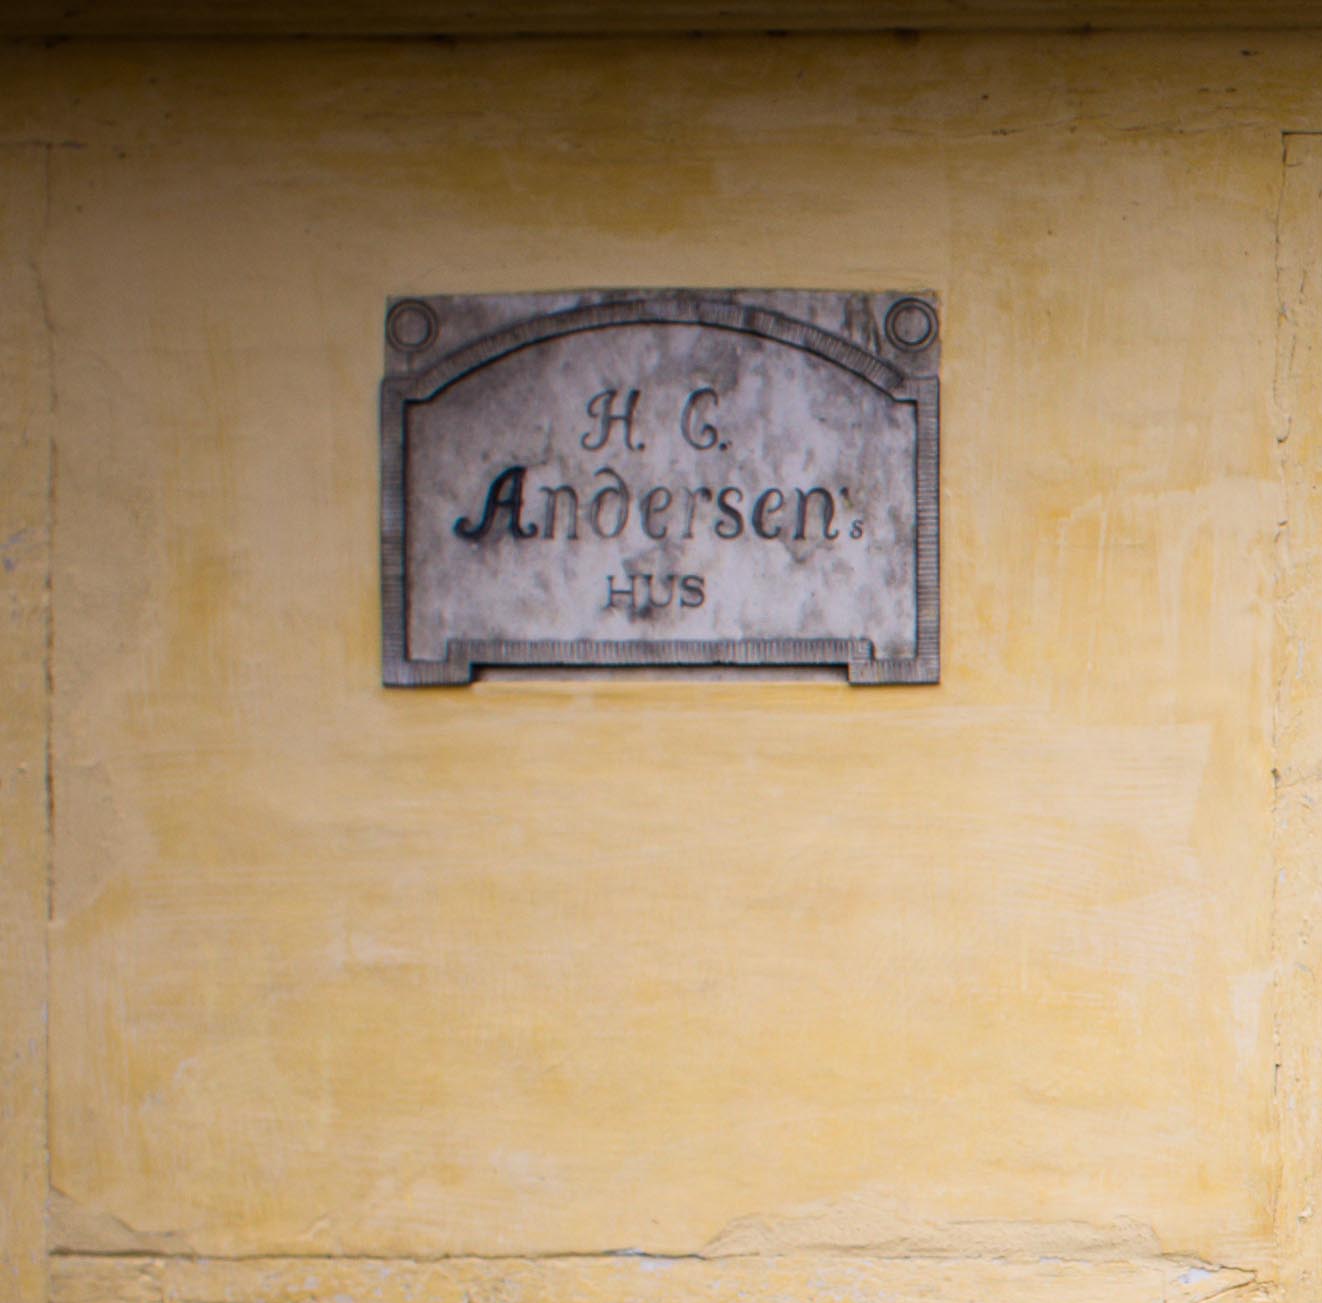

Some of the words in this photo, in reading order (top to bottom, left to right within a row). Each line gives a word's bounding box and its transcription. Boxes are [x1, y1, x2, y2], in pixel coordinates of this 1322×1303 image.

[580, 388, 646, 452] H.
[452, 464, 864, 543] Andersen's
[604, 574, 707, 611] HUS
